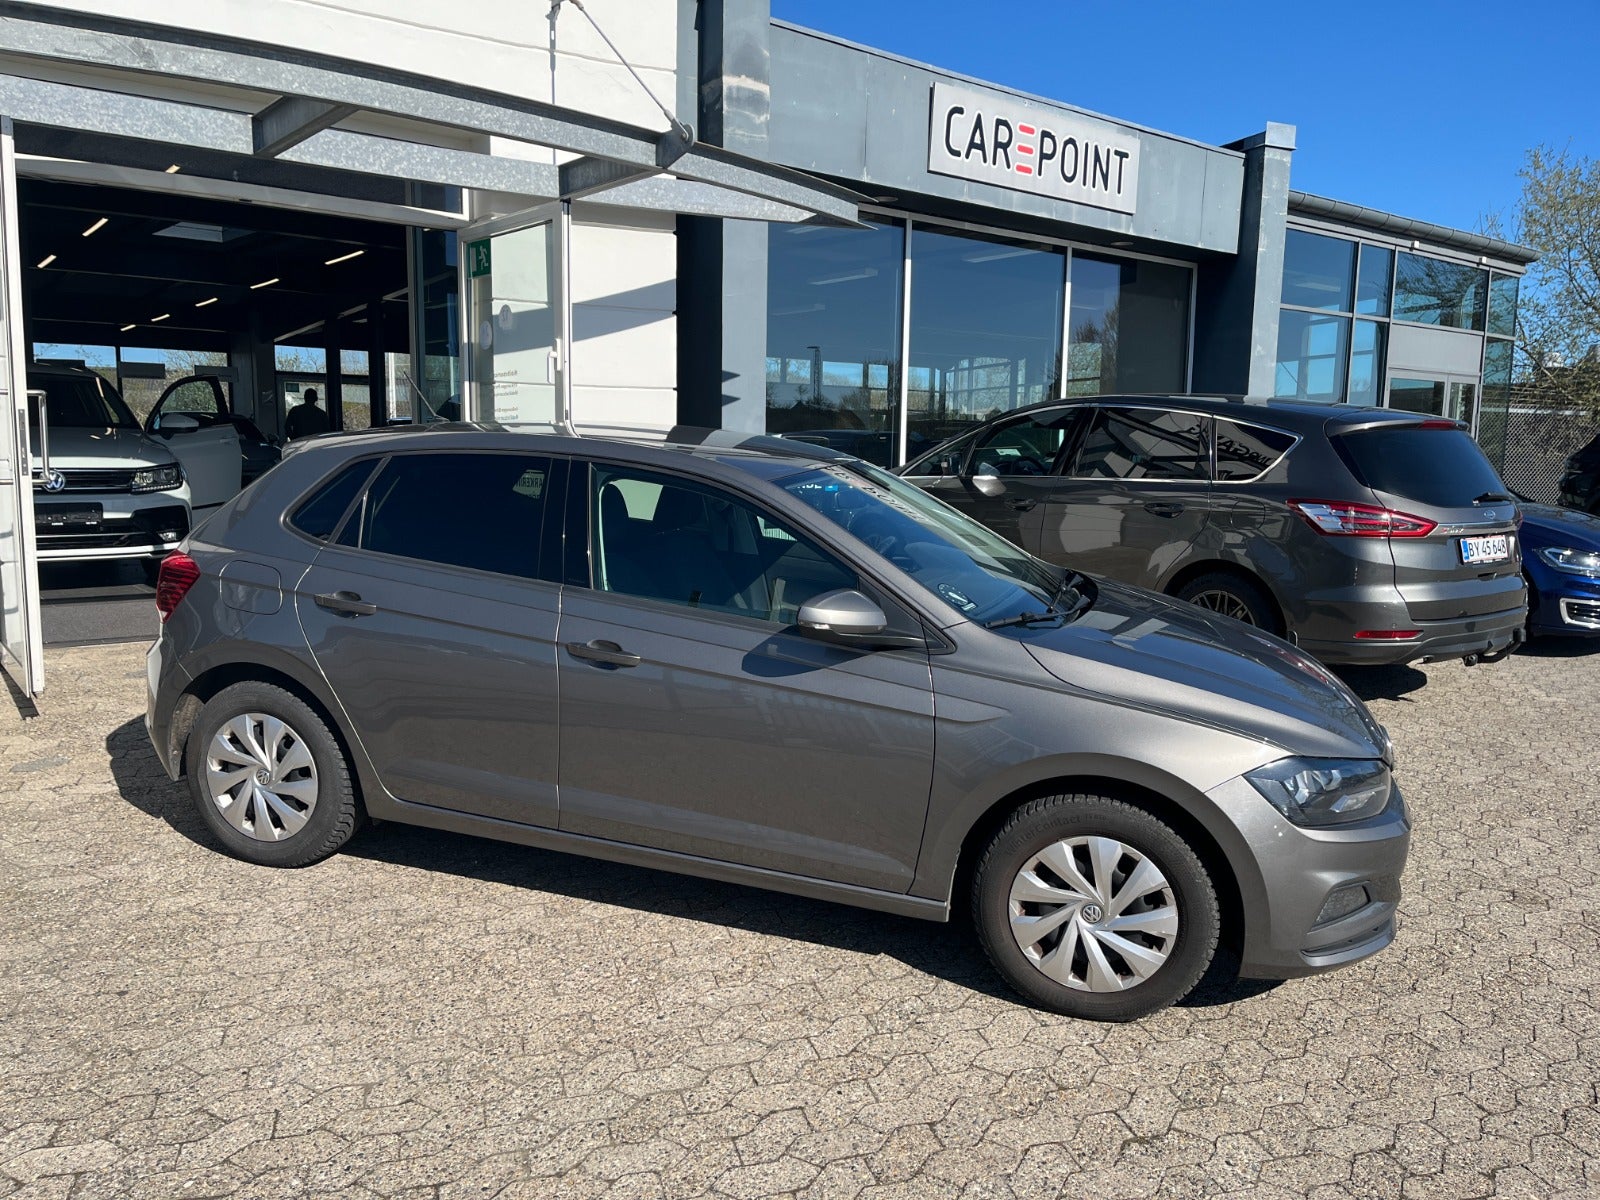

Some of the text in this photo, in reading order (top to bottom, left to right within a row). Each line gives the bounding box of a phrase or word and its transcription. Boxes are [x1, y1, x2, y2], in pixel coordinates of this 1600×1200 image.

[945, 106, 1129, 194] CAREPOINT
[1468, 539, 1507, 557] BY 45 648
